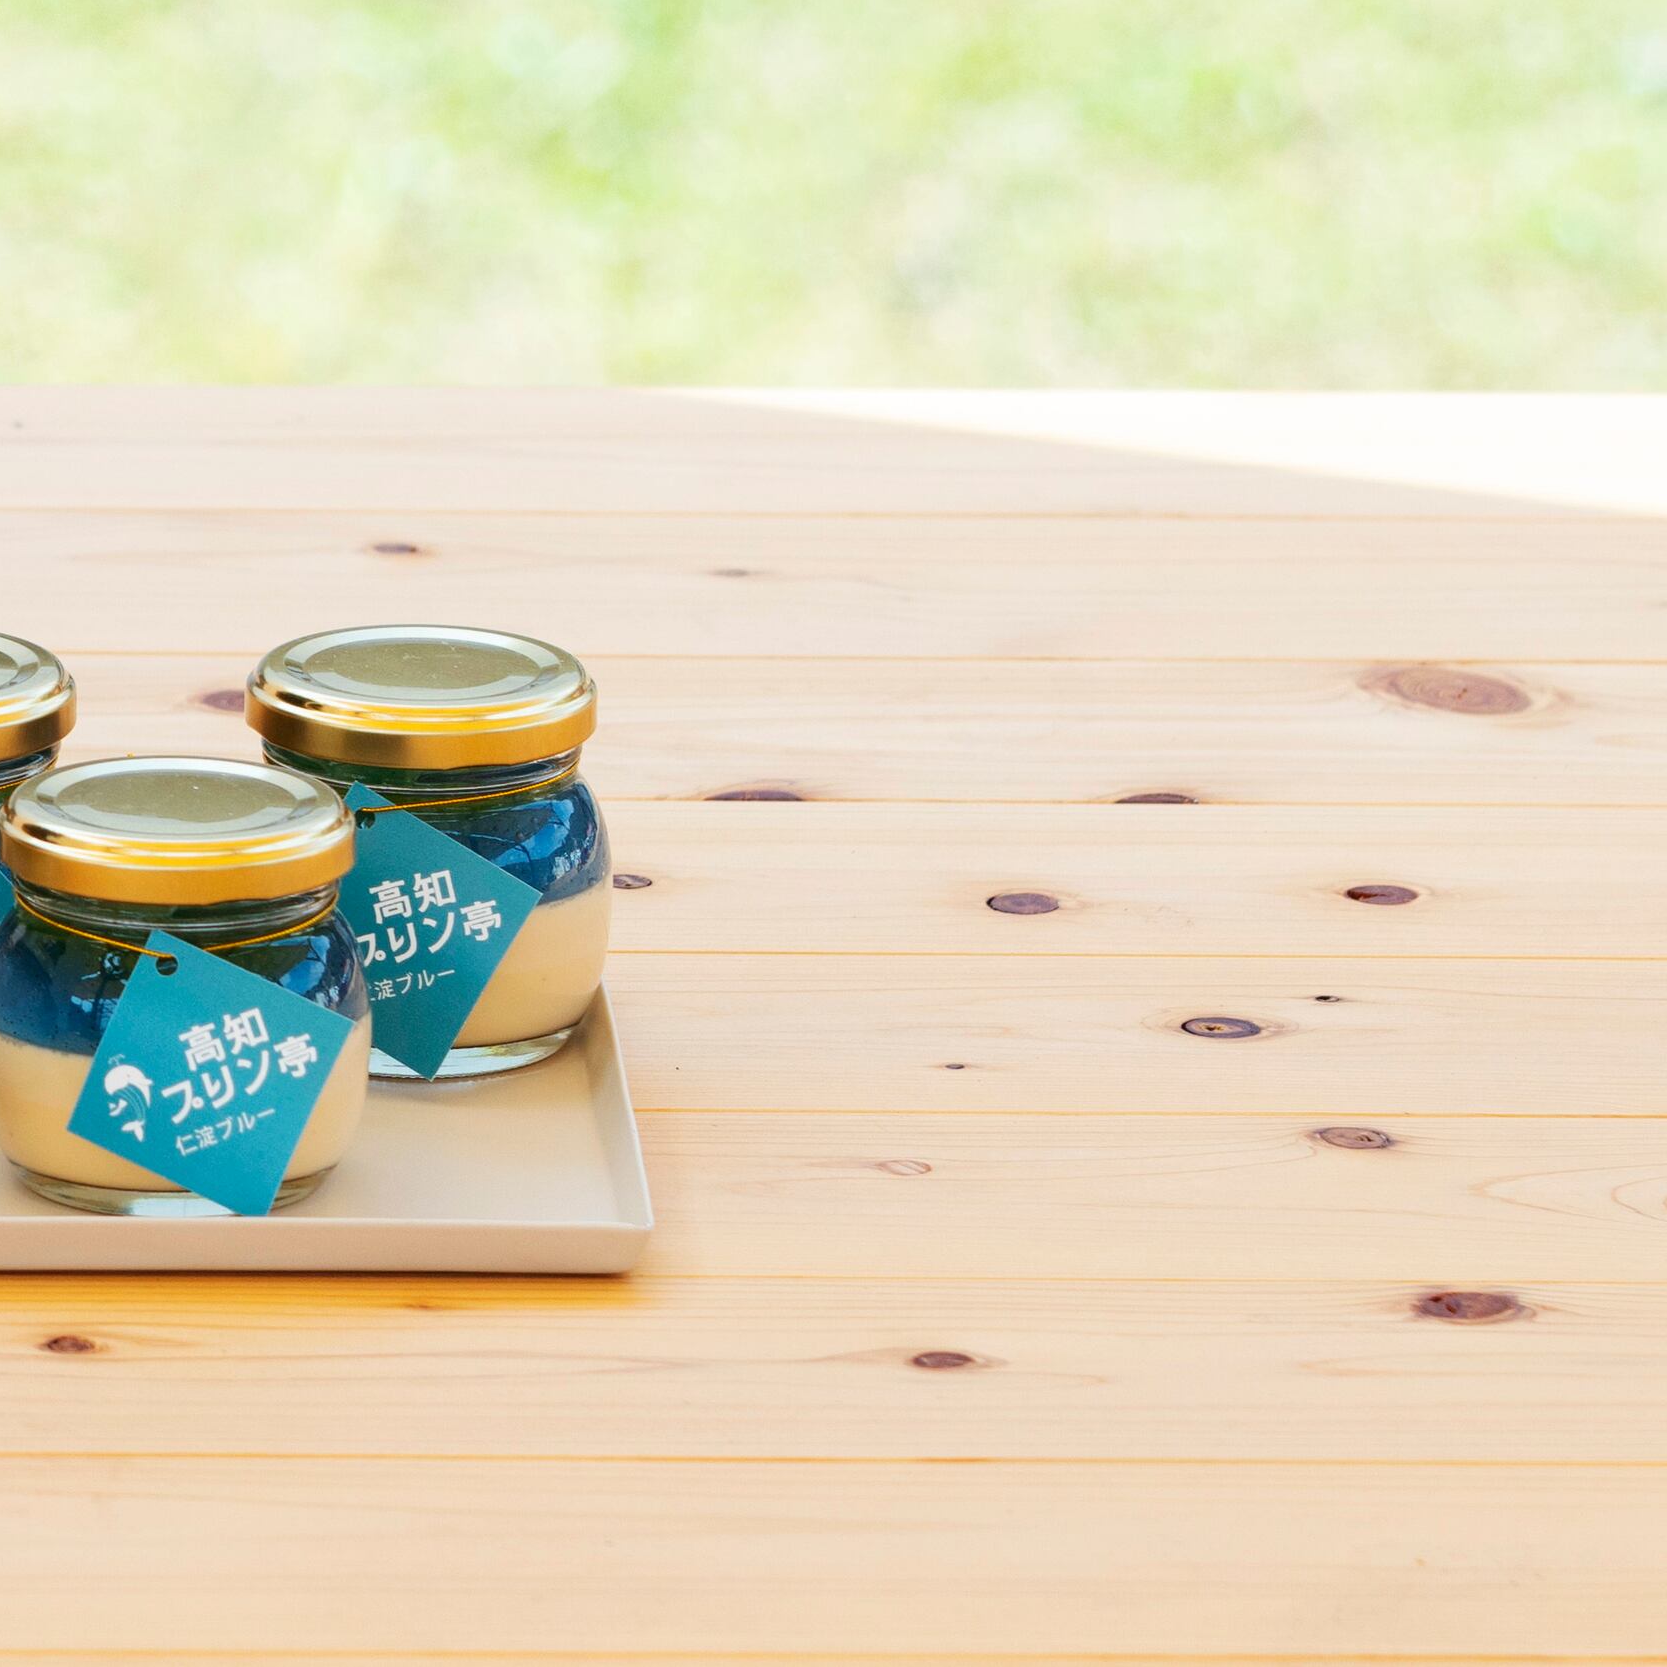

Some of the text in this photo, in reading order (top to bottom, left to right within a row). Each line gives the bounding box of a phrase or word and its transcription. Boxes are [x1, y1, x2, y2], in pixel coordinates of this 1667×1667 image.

[369, 869, 458, 924] 高知
[355, 899, 502, 968] プリン亭
[369, 968, 455, 1003] 淀ブルー
[178, 1007, 270, 1072] 高知
[160, 1033, 318, 1125] プリン亭
[175, 1107, 276, 1157] 仁淀ブルー
